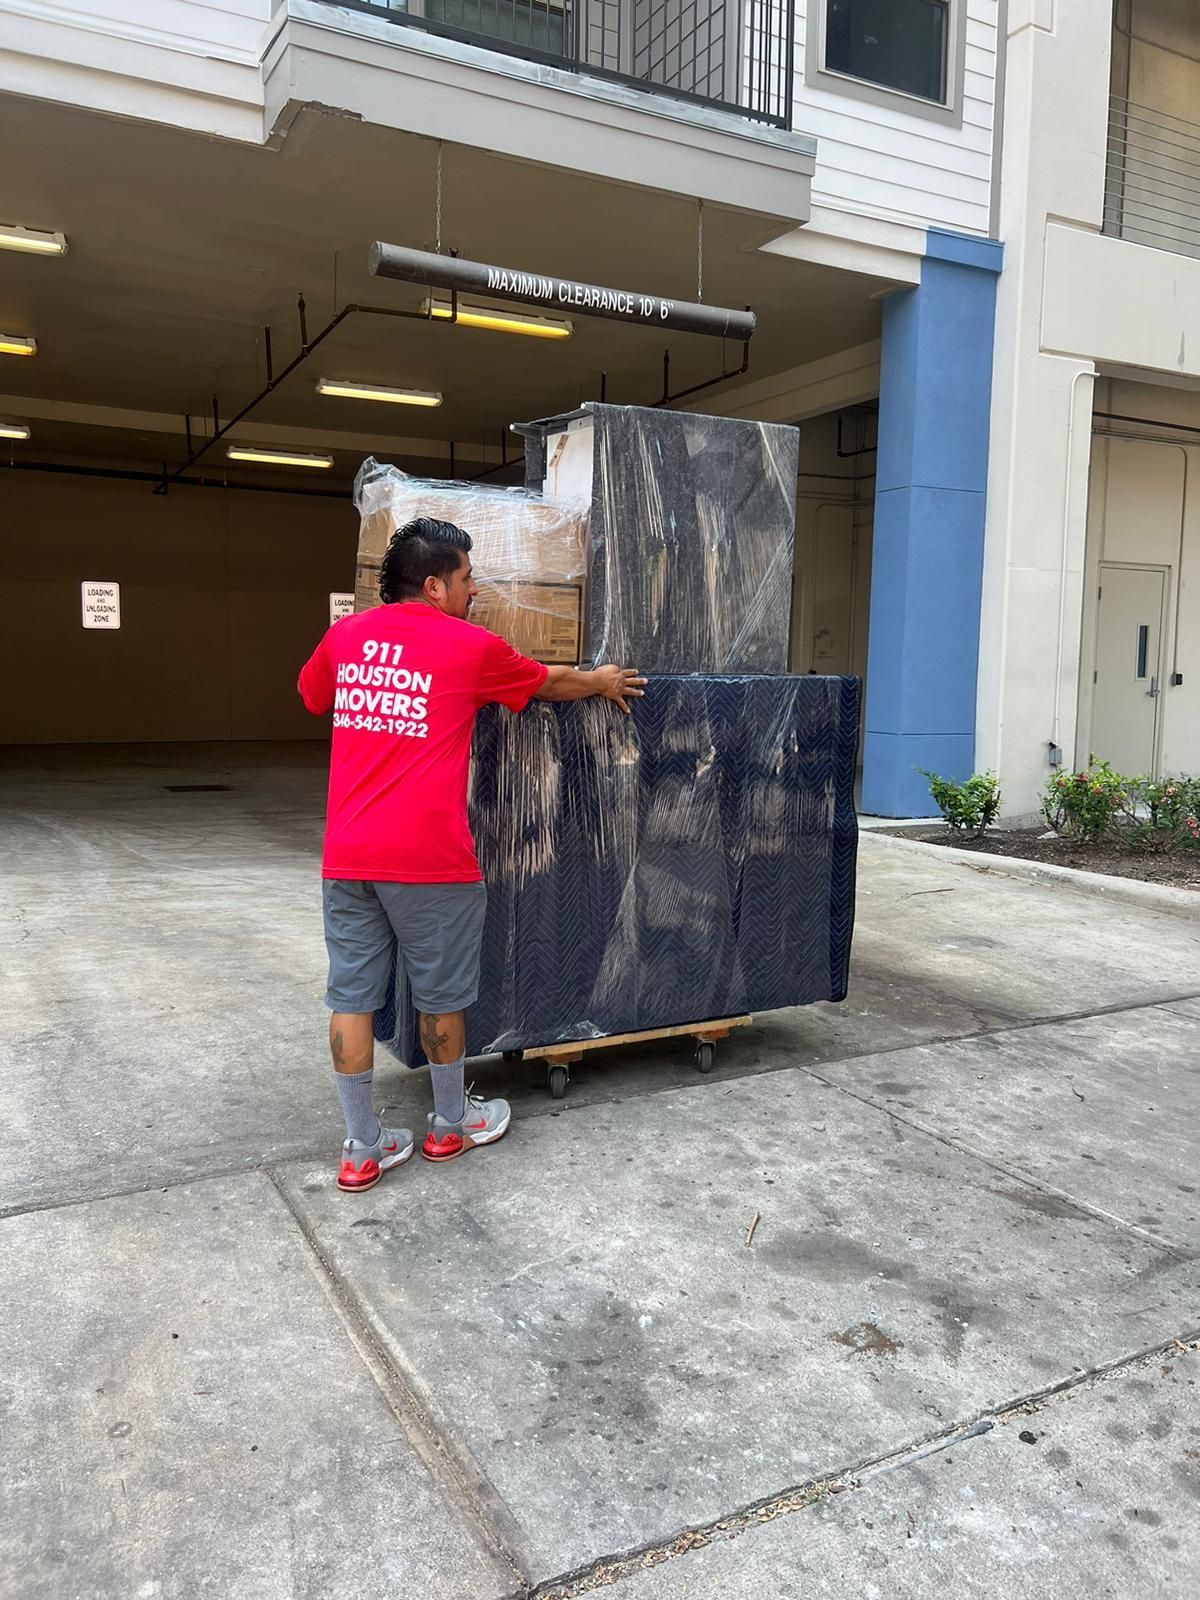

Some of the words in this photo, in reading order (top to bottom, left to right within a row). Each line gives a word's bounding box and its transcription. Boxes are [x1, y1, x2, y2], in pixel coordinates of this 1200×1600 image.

[487, 268, 553, 299] MAXIMUM
[558, 282, 634, 314] CLEARANCE
[86, 605, 116, 613] UNLOADING
[94, 615, 109, 623] ZONE
[362, 639, 404, 665] 911
[336, 663, 432, 694] HOUSTON
[334, 687, 428, 720] MOVERS
[333, 712, 429, 738] 346-542-1922
